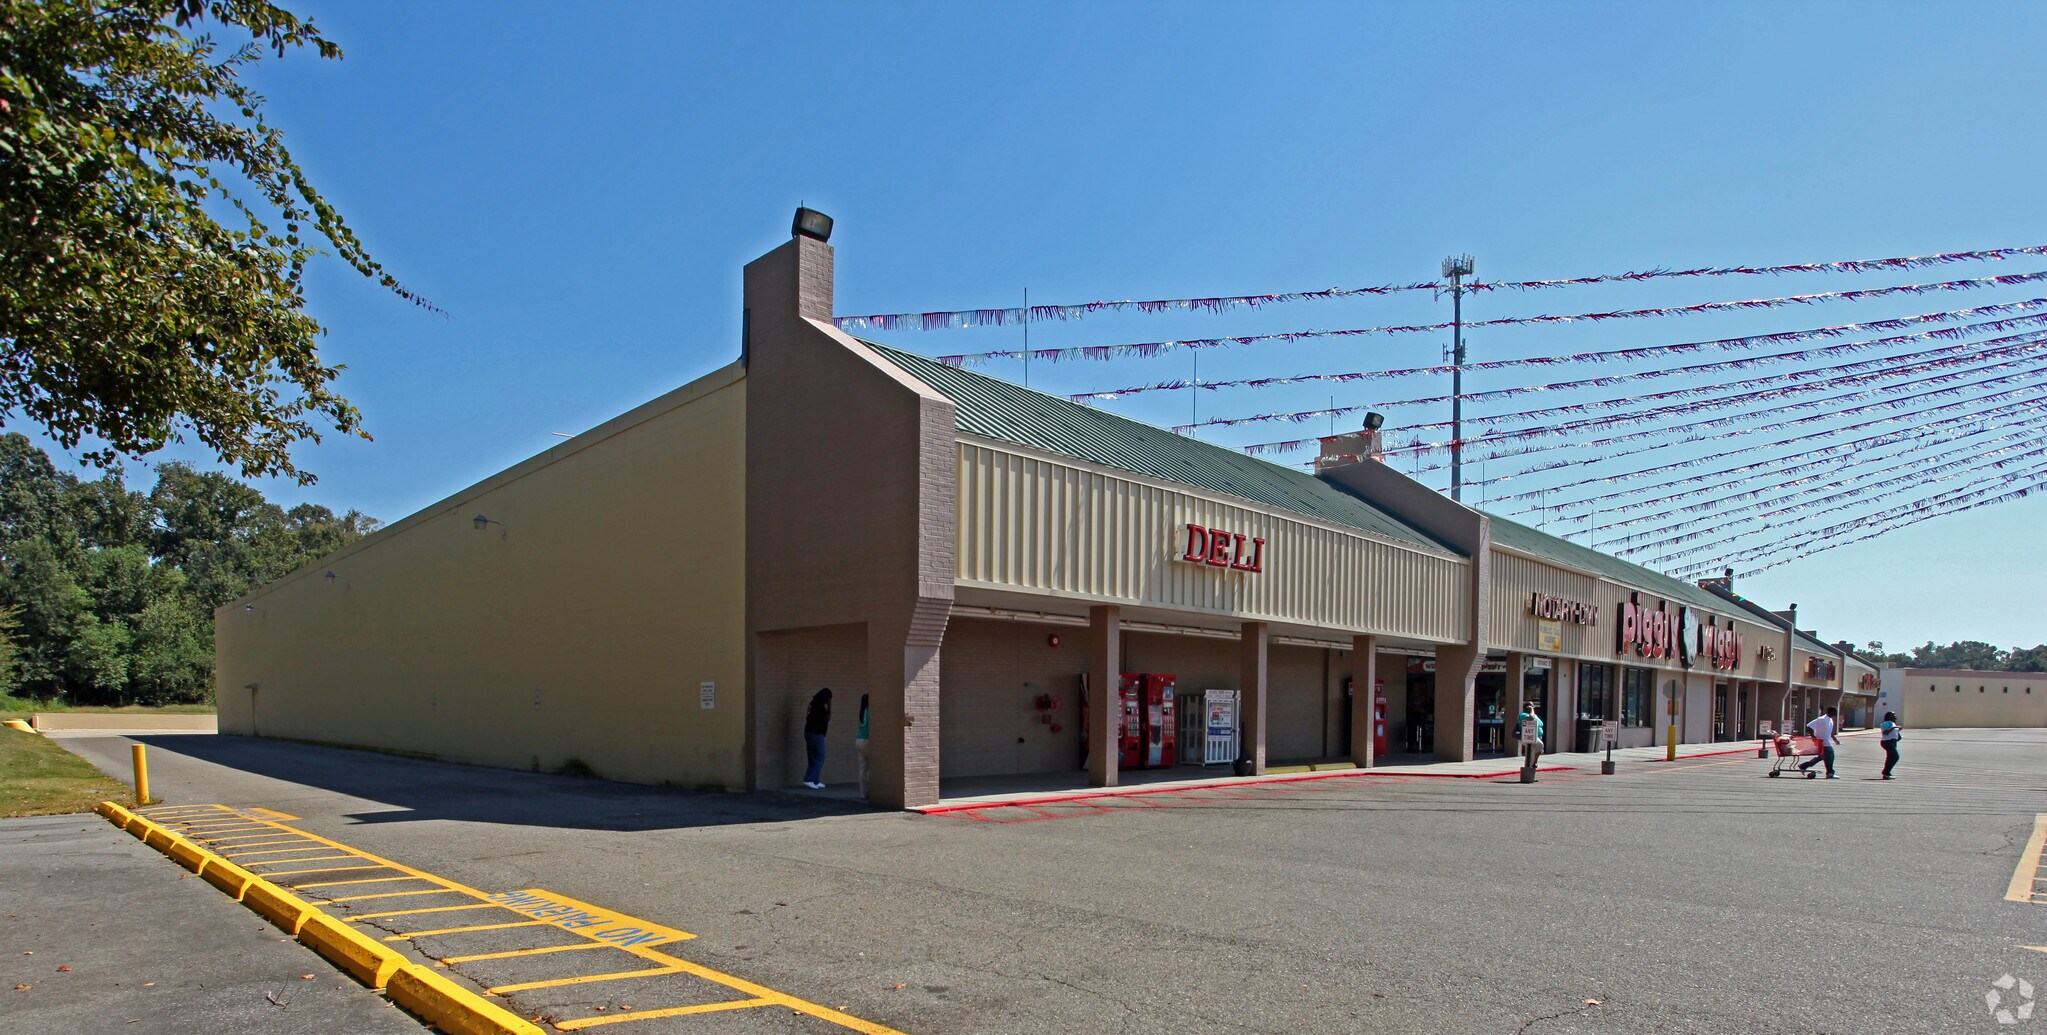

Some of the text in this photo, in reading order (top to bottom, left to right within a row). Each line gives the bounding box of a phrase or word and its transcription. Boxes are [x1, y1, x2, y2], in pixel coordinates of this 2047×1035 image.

[1183, 523, 1265, 573] DELI
[1617, 592, 1679, 659] piggly
[1698, 615, 1743, 670] wiggly
[594, 927, 667, 947] NO
